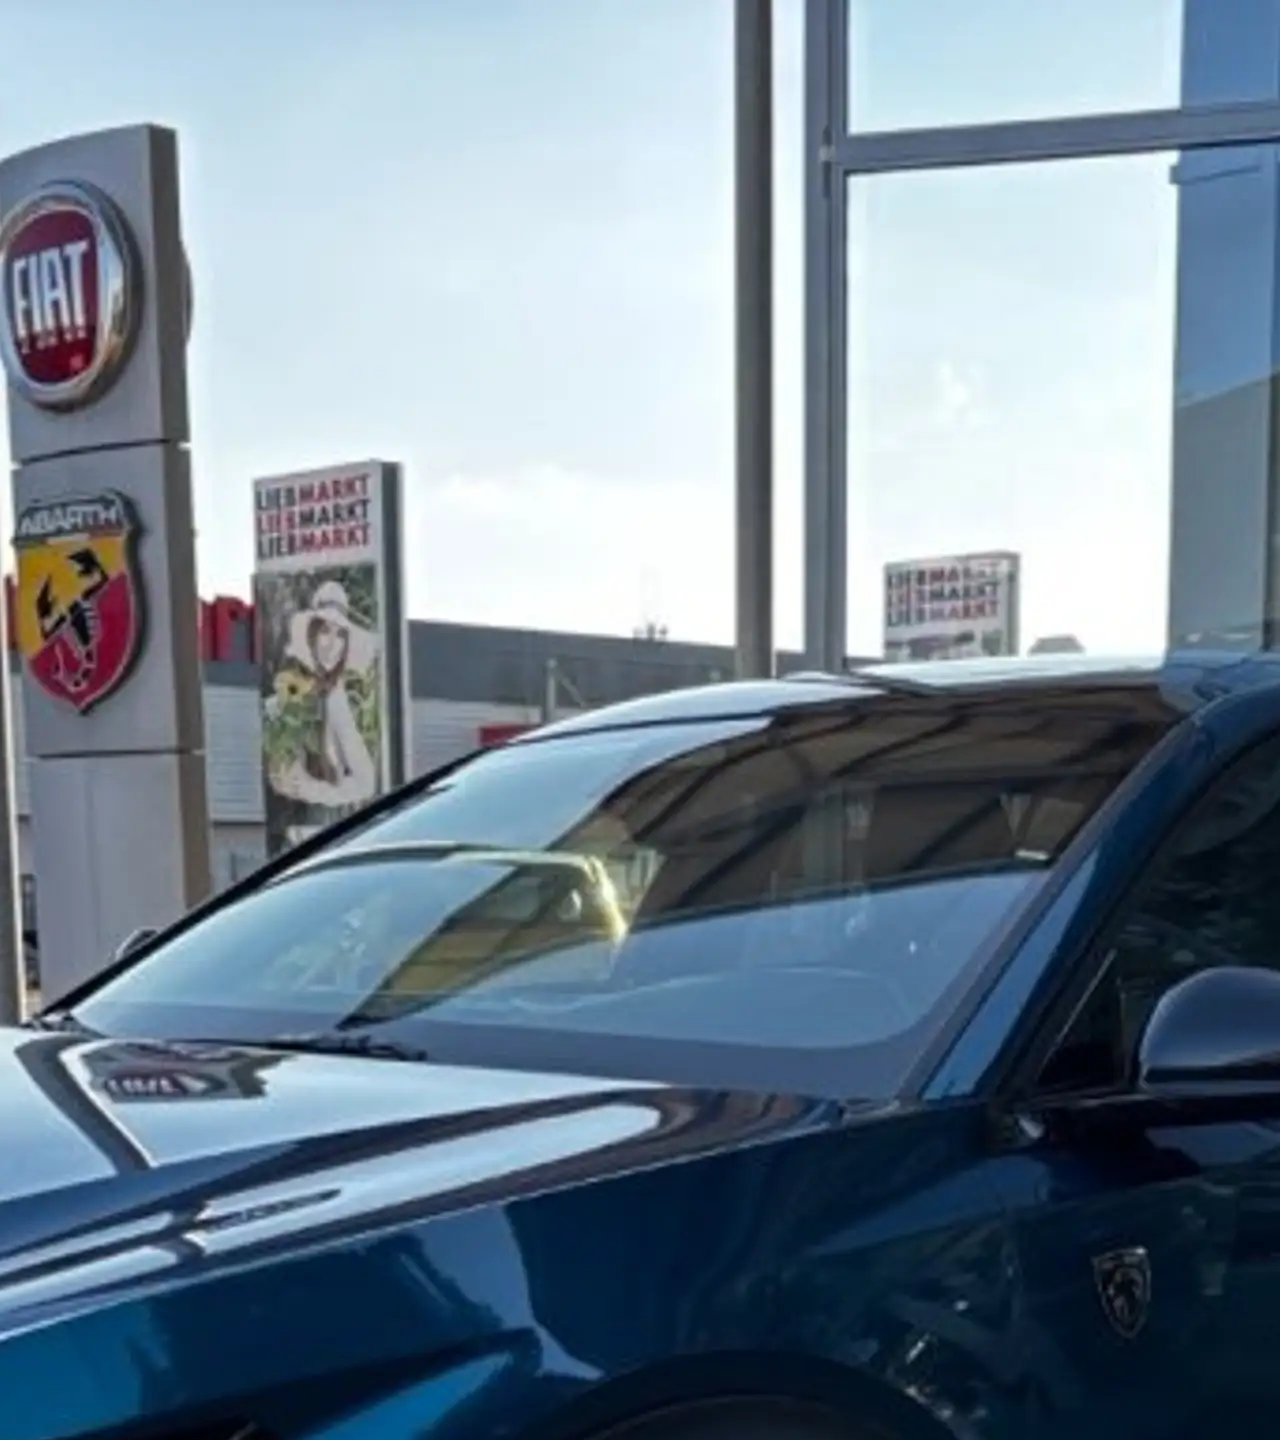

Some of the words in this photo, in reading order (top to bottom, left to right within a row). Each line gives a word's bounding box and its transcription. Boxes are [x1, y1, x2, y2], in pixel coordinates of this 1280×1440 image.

[13, 239, 88, 339] FIAT
[256, 473, 371, 511] LIEBMARKT
[20, 500, 118, 536] ABARTH
[257, 498, 371, 535] LIEBMARKT
[257, 522, 371, 559] LIEBMARKT
